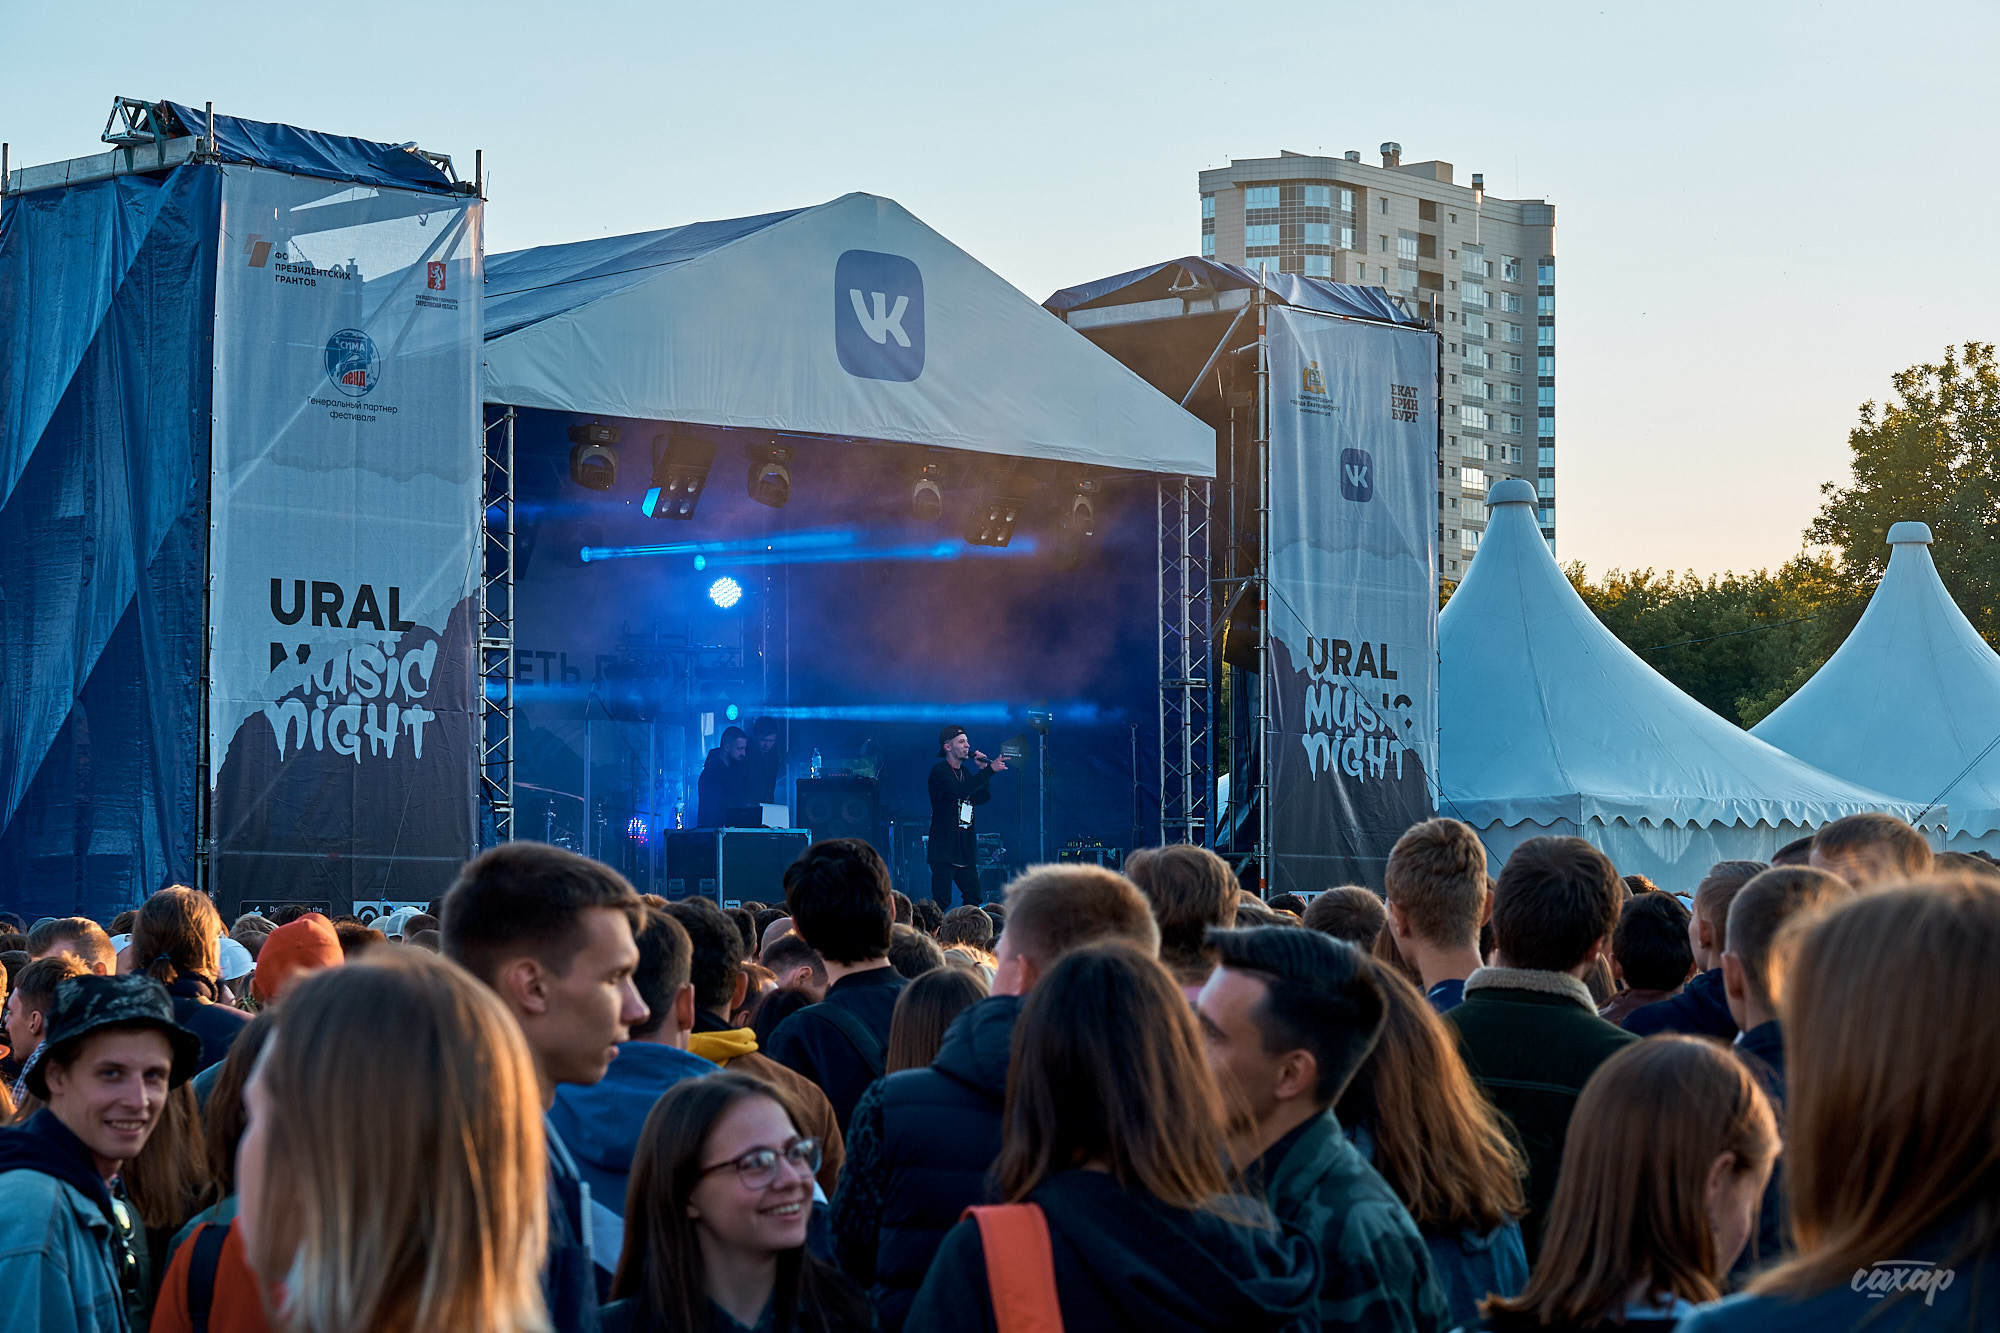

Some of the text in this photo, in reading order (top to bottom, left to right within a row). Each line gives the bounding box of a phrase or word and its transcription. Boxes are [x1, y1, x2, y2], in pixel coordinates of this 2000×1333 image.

[275, 263, 351, 280] ПРЕЗИДЕНТСКИХ
[275, 275, 317, 287] ГРАНТОВ
[849, 288, 912, 348] VK
[1391, 383, 1418, 398] ЕКАТ
[307, 395, 398, 415] Генеральный партнер
[1391, 396, 1418, 410] ЕРИН
[330, 410, 377, 422] фестиваля
[1391, 408, 1418, 423] БУРГ
[1345, 463, 1369, 489] VK
[270, 578, 416, 632] URAL
[1307, 636, 1398, 681] URAL
